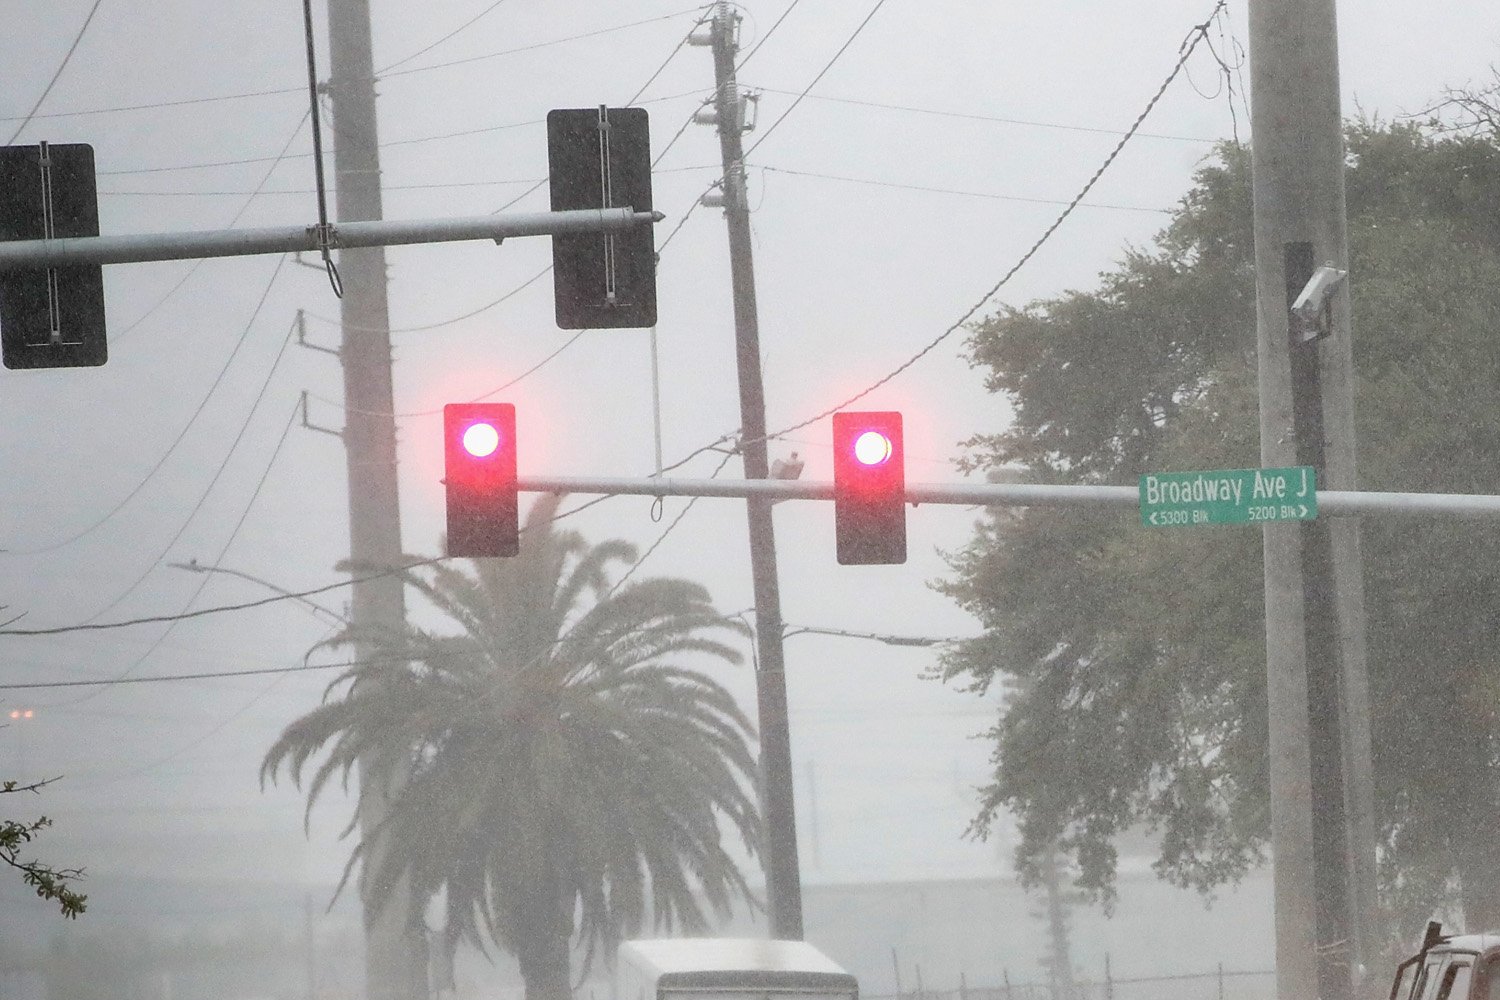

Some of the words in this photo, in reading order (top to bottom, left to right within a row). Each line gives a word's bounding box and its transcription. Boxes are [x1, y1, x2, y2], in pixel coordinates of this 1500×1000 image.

[1146, 475, 1243, 506] Broadway
[1253, 470, 1286, 499] Ave
[1296, 469, 1308, 498] J
[1160, 511, 1188, 525] 5300
[1192, 510, 1209, 523] Blk
[1248, 506, 1276, 521] 5200
[1280, 505, 1297, 519] Blk
